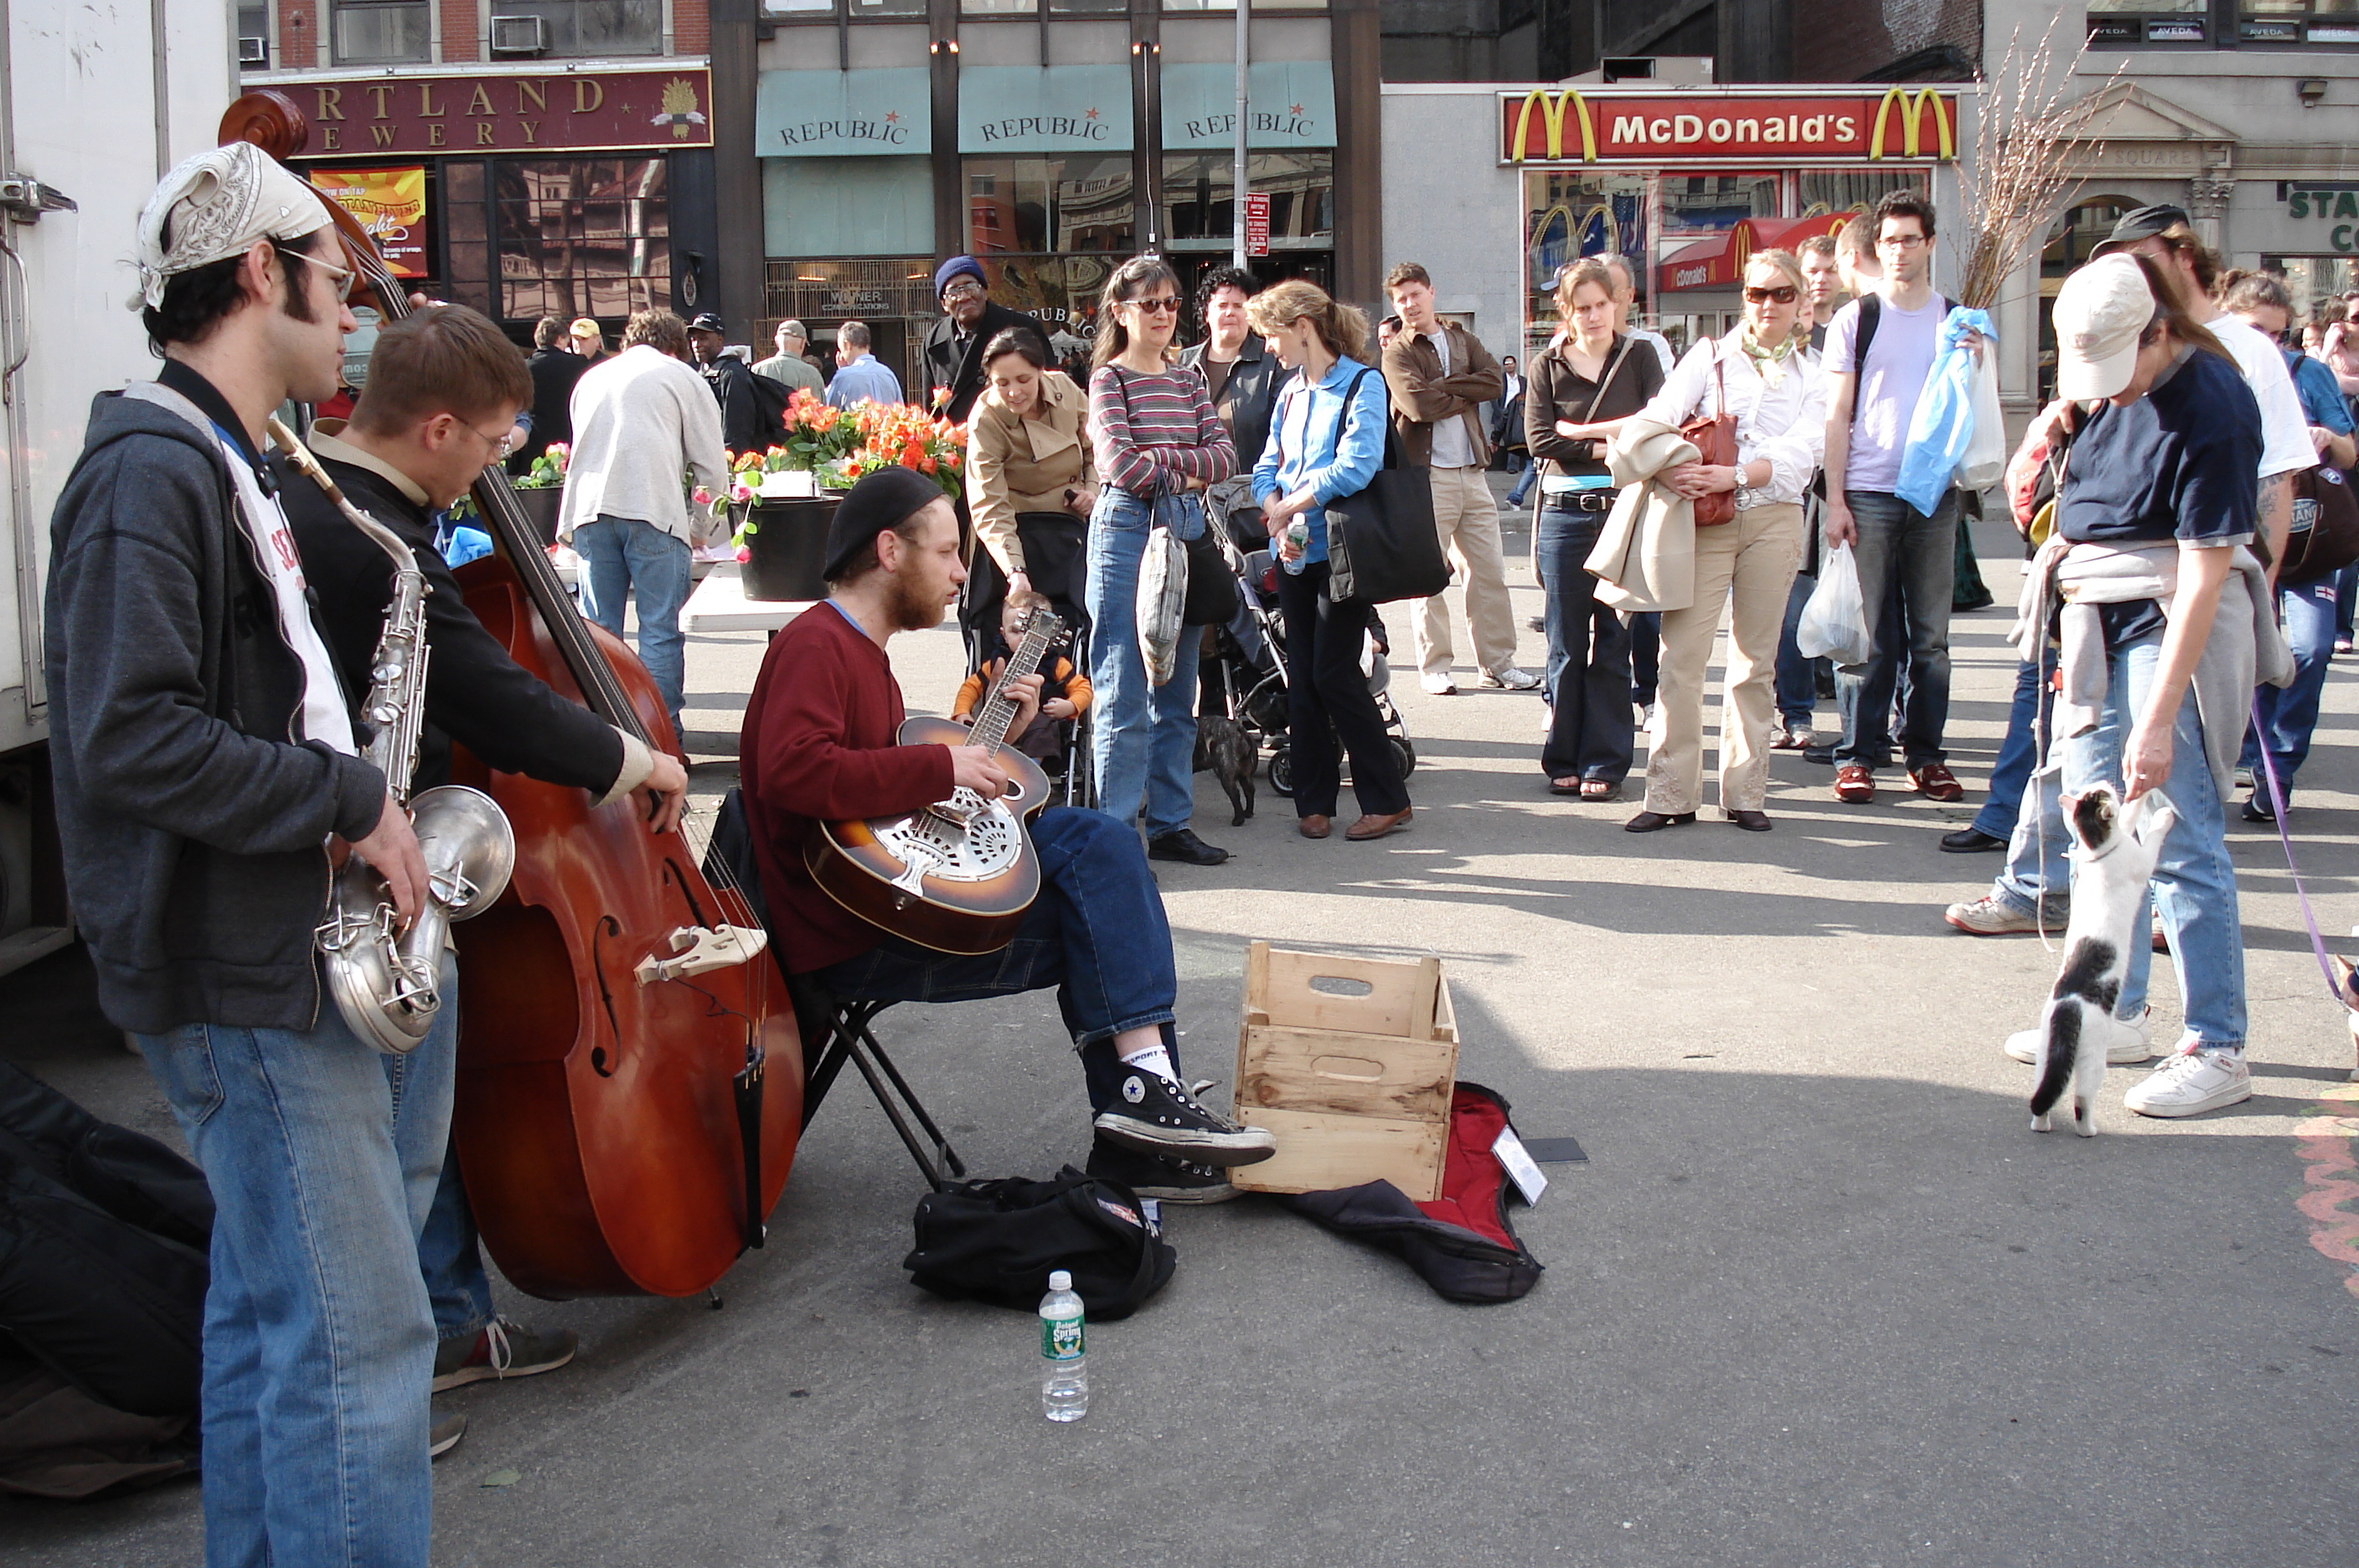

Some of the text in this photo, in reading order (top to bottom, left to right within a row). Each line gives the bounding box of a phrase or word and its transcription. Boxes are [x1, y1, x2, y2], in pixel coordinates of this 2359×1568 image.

[2157, 27, 2193, 35] AVEDA
[314, 79, 605, 121] RTLAND
[323, 121, 541, 150] EWERY
[779, 120, 909, 147] REPUBLIC
[979, 116, 1109, 142] REPUBLIC
[1610, 114, 1856, 144] McDonald's
[2114, 148, 2191, 165] SQUARE
[338, 188, 350, 197] ON
[352, 187, 366, 196] TAP
[2289, 191, 2359, 219] STA
[337, 198, 374, 214] DIAN
[2331, 224, 2359, 252] C
[1027, 307, 1097, 338] PUBLIC
[1130, 1050, 1158, 1064] SPORT
[1053, 1326, 1081, 1343] Spring
